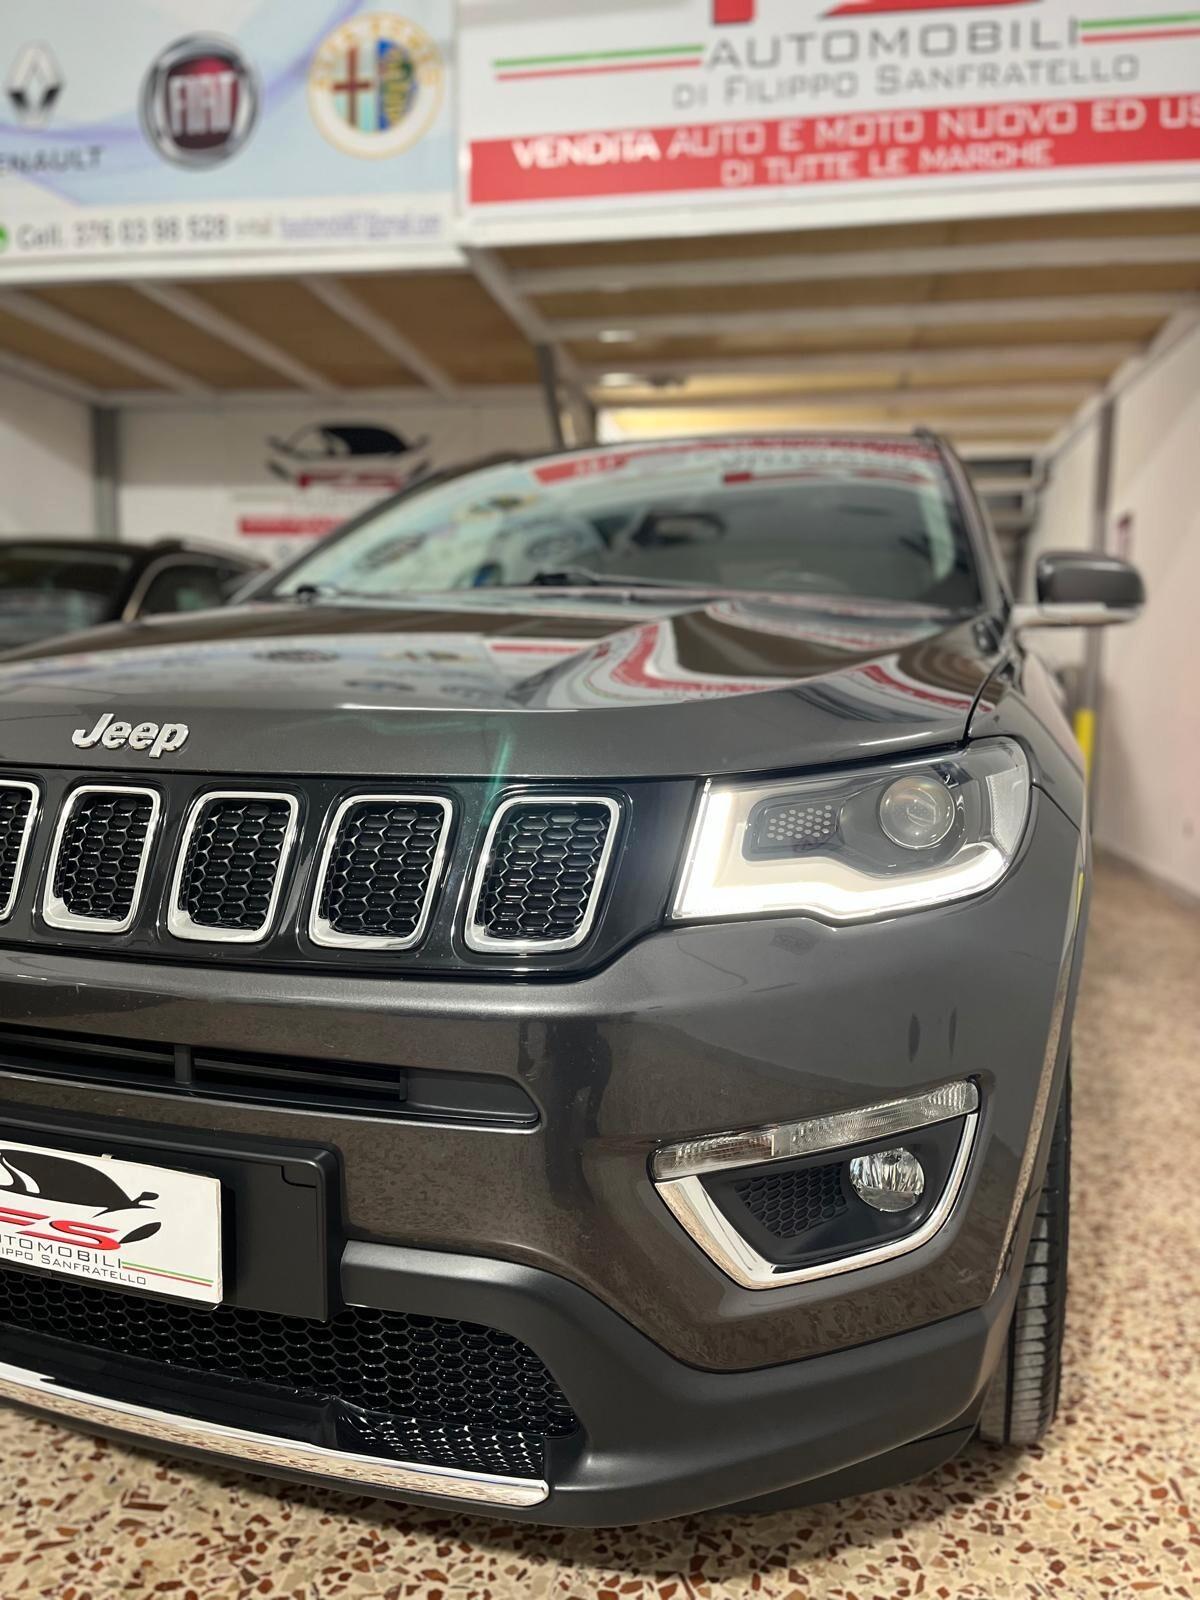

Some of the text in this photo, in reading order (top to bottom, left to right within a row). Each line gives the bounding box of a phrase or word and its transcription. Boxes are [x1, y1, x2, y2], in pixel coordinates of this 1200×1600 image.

[708, 16, 1079, 70] AUTOMOBILI
[169, 70, 236, 136] FIAT
[672, 54, 1140, 110] DI FILIPPO SANFRATELLO
[511, 130, 662, 169] VENDITA
[666, 120, 767, 158] AUTO
[777, 119, 804, 150] E
[814, 110, 925, 149] MOTO
[937, 102, 1078, 140] NUOVO
[1091, 98, 1147, 133] ED
[719, 140, 1054, 186] DI TUTTE LE MARCHE
[71, 713, 190, 759] Jeep
[0, 1233, 121, 1269] TOMOBILI
[41, 1254, 147, 1286] SANFRATELLO
